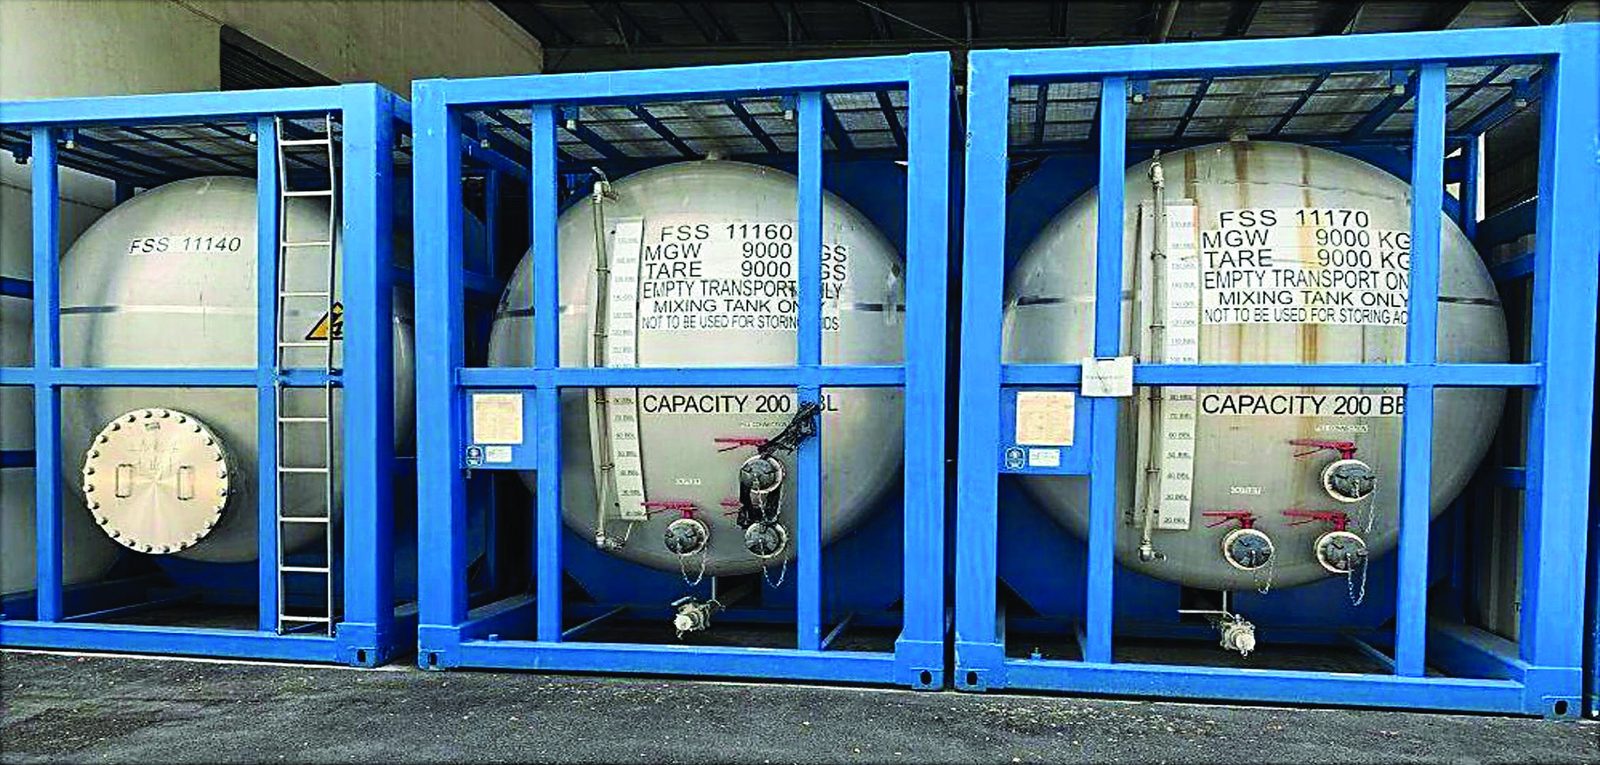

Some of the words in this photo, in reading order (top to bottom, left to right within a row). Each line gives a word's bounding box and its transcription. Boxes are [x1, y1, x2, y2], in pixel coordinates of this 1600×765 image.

[1219, 209, 1277, 228] FSS
[1296, 209, 1369, 228] 11170
[660, 224, 710, 242] FSS
[726, 224, 793, 240] 11160
[1202, 229, 1269, 249] MGW
[1315, 228, 1370, 248] 9000
[1378, 231, 1411, 250] KG
[129, 236, 170, 254] FSS
[183, 236, 242, 252] 11140
[644, 243, 702, 261] MGW
[742, 241, 793, 259] 9000
[820, 244, 848, 263] GS
[1203, 249, 1274, 269] TARE
[1317, 248, 1373, 268] 9000
[1380, 251, 1410, 271] KG
[645, 261, 702, 280] TARE
[741, 260, 792, 278] 9000
[820, 263, 847, 282] GS
[1204, 270, 1266, 289] EMPTY
[1272, 269, 1380, 289] TRANSPORT
[643, 280, 696, 299] EMPTY
[700, 279, 797, 298] TRANSPORT
[653, 299, 717, 313] MIXING
[723, 299, 772, 313] TANK
[1218, 290, 1294, 306] MIXING
[1300, 290, 1354, 306] TANK
[1360, 292, 1408, 308] ONLY
[642, 315, 663, 330] NOT
[666, 315, 681, 329] TO
[683, 315, 697, 330] BE
[699, 315, 730, 329] USED
[731, 315, 755, 329] FOR
[757, 315, 798, 330] STORIN
[1205, 307, 1230, 323] NOT
[1233, 308, 1250, 323] TO
[1253, 307, 1270, 323] BE
[1273, 308, 1308, 323] USED
[1311, 308, 1337, 324] FOR
[1339, 308, 1391, 325] STORING
[643, 394, 749, 413] CAPACITY
[755, 394, 792, 413] 200
[1202, 395, 1328, 415] CAPACITY
[1333, 395, 1373, 415] 200
